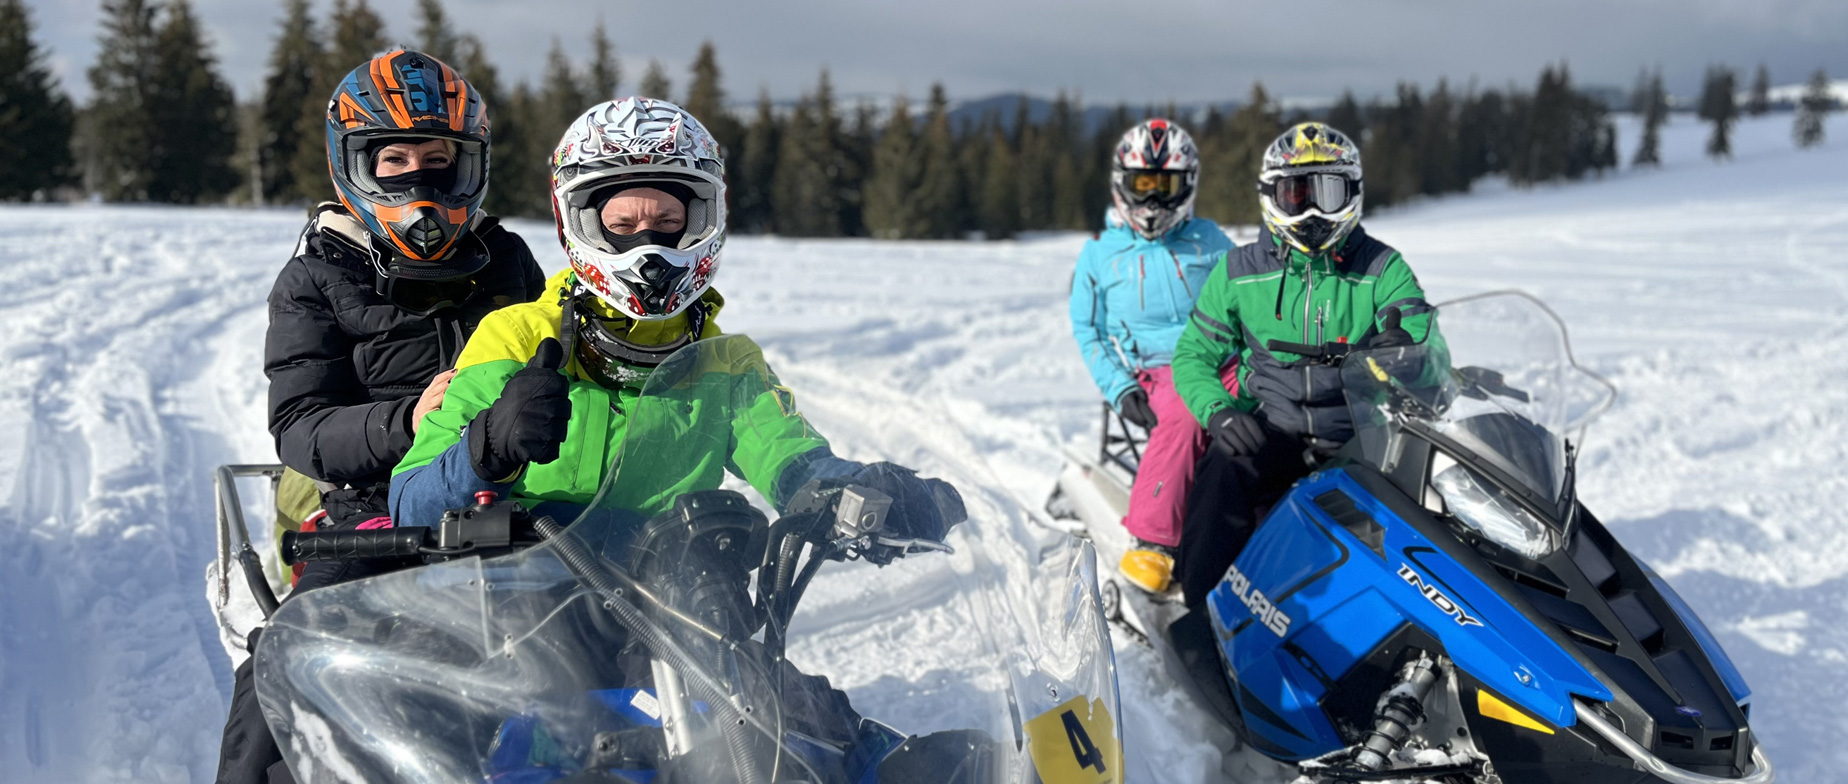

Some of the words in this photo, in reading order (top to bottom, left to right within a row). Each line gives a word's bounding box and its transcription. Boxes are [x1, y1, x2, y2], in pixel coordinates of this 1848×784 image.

[1224, 565, 1291, 638] POLARIS
[1397, 562, 1485, 627] INDY
[1061, 709, 1106, 774] 4
